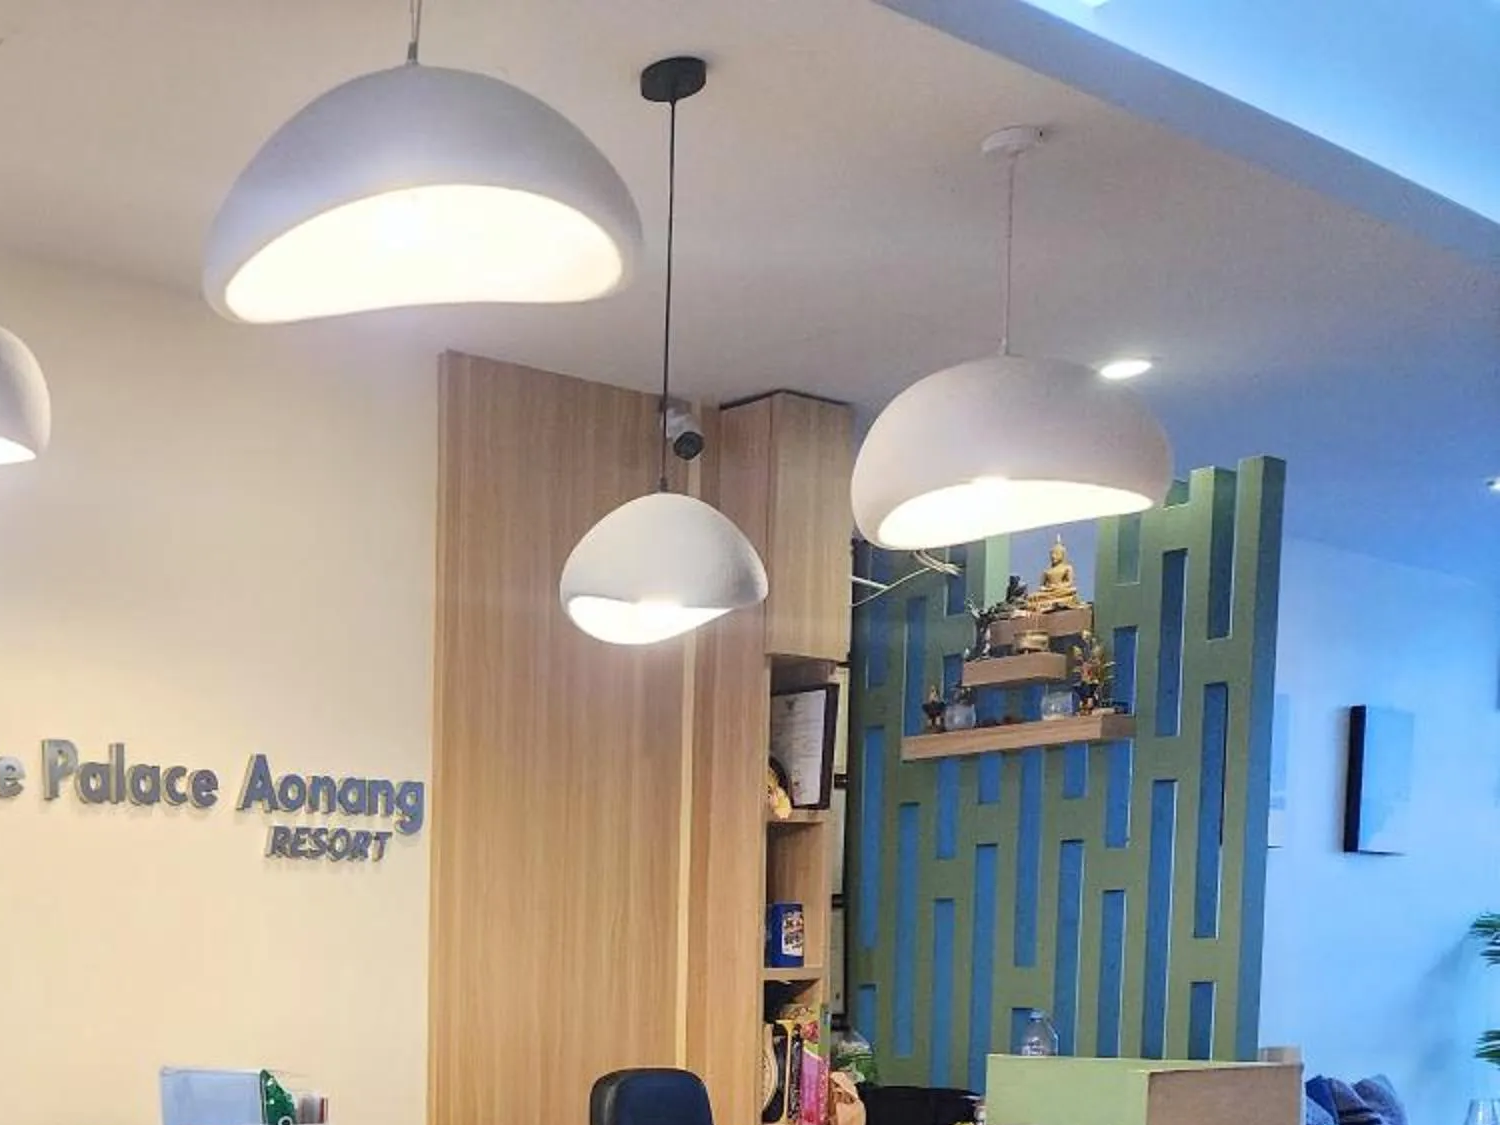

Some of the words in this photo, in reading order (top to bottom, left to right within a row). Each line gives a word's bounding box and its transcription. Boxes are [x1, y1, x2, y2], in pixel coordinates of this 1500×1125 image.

[41, 738, 220, 809] Palace
[235, 752, 425, 835] Aonang
[264, 824, 393, 862] RESORT
